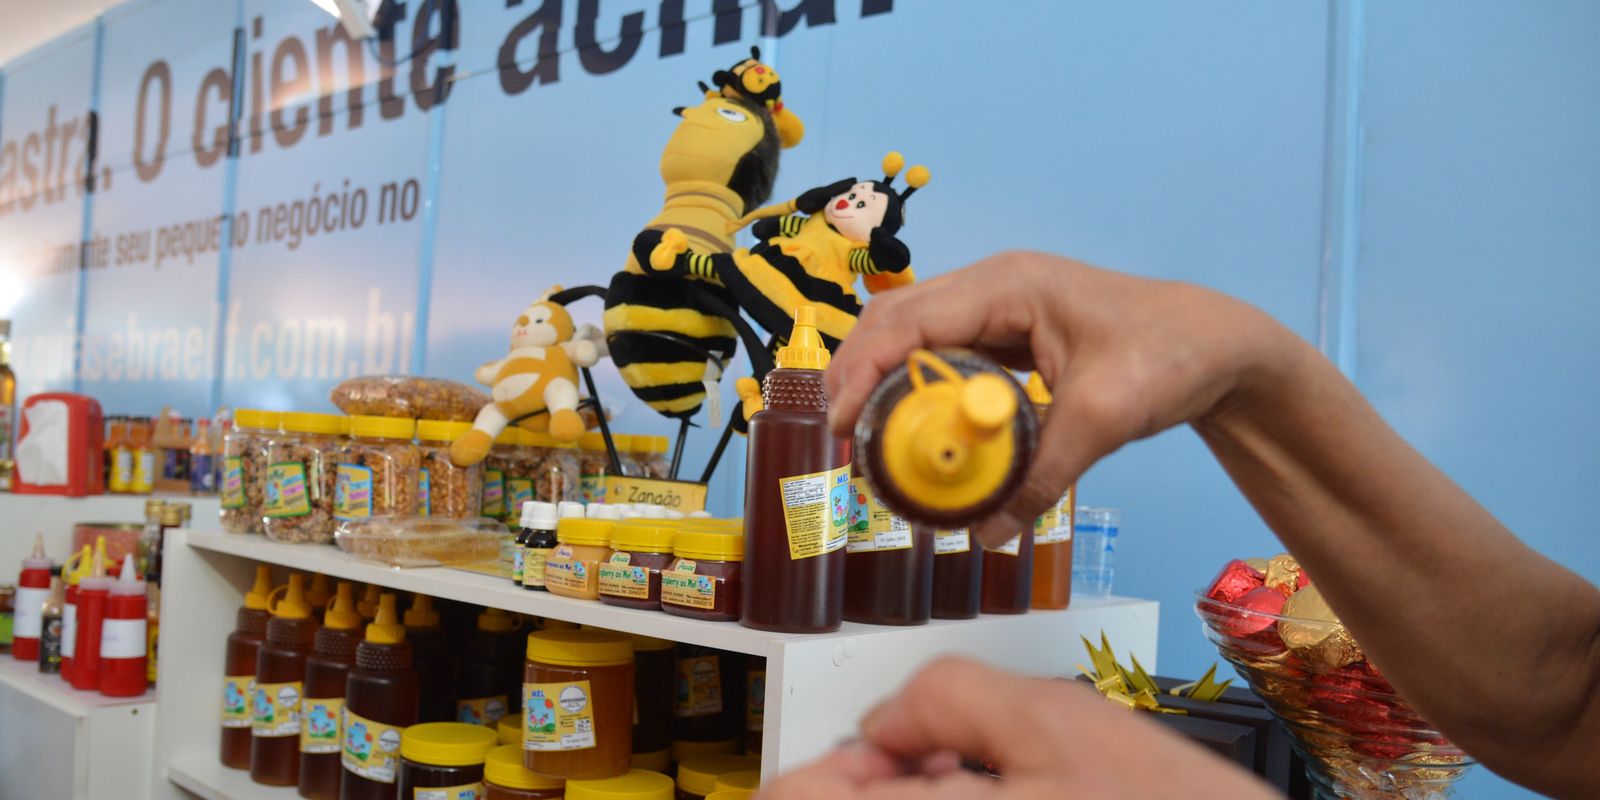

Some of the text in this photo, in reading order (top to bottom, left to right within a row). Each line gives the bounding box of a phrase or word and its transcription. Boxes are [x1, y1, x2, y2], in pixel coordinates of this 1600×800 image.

[133, 58, 173, 183] O
[192, 0, 460, 168] cliente
[115, 232, 150, 264] seu
[155, 213, 250, 269] pequeno
[256, 178, 369, 250] negócio
[379, 178, 421, 225] no
